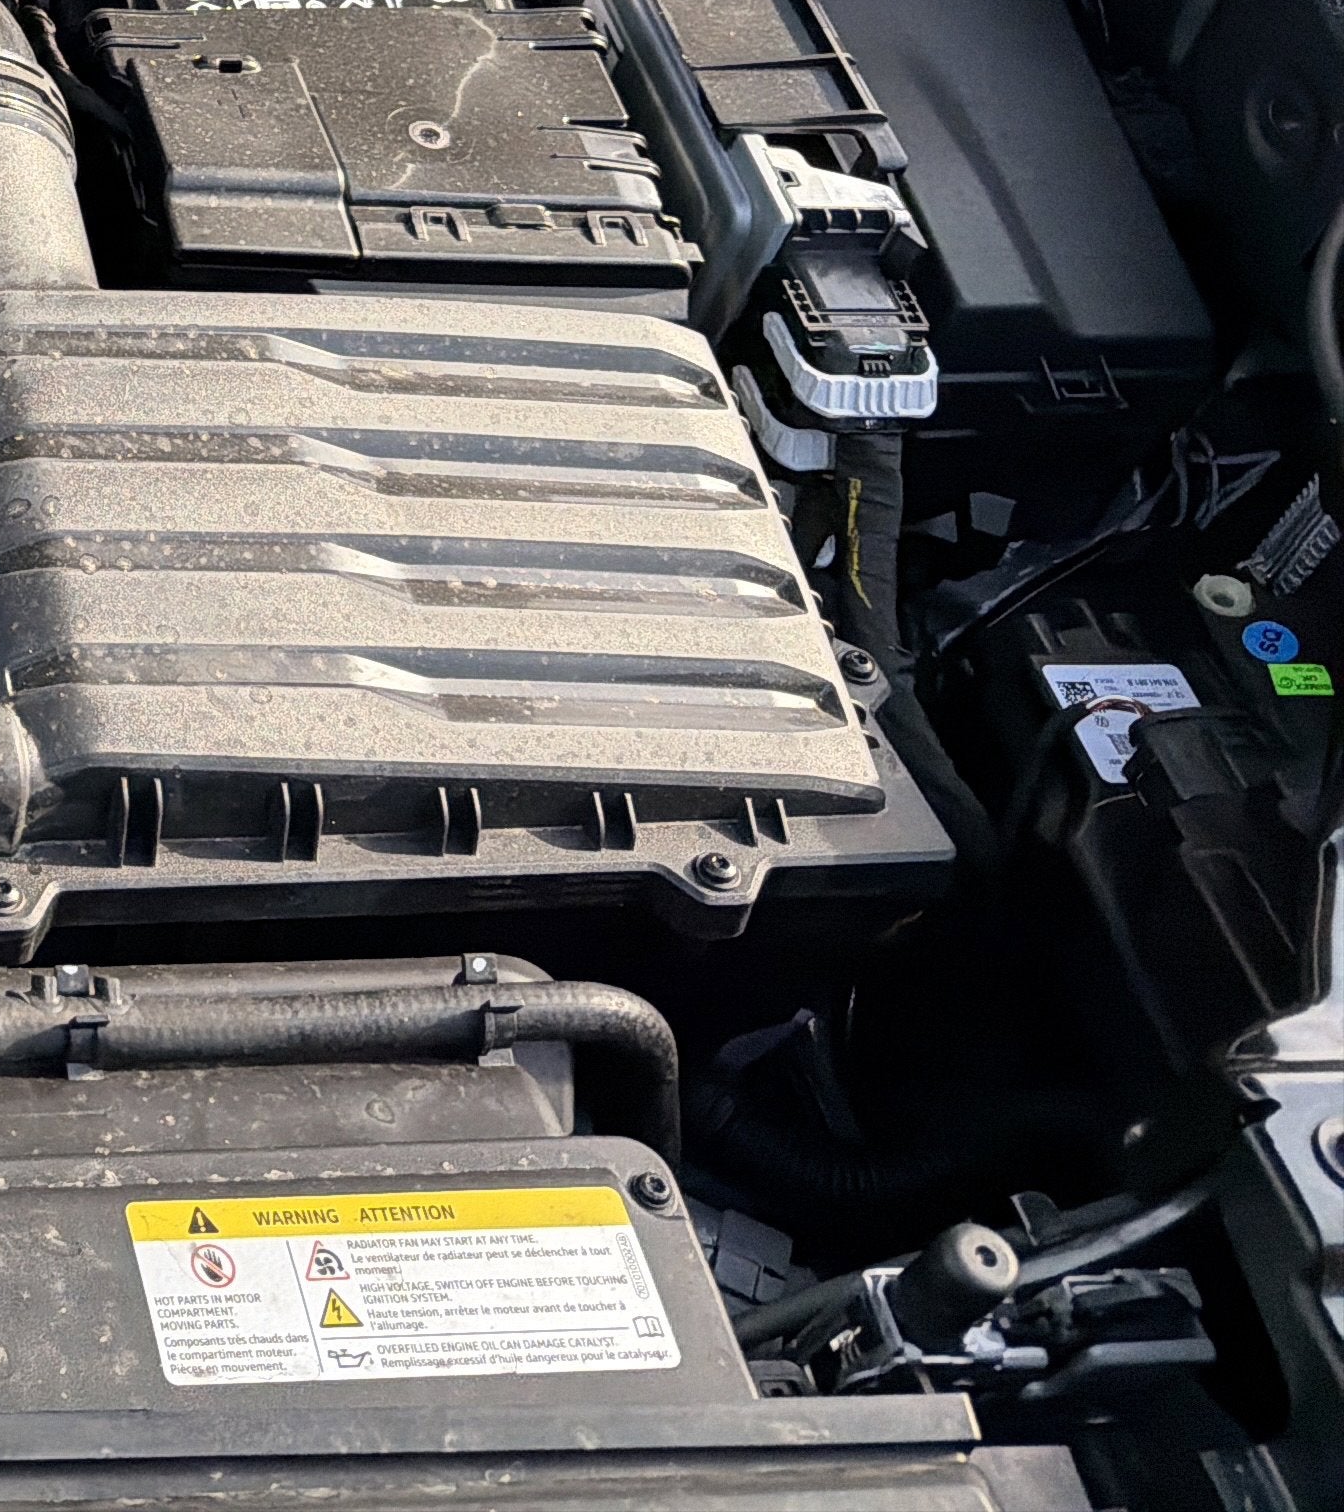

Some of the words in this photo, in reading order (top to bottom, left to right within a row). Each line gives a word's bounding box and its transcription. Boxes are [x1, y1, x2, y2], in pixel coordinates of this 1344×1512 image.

[252, 1209, 339, 1226] WARNING
[359, 1204, 456, 1223] ATTENTION
[346, 1238, 397, 1250] RADIATOR
[398, 1237, 419, 1248] FAN
[421, 1236, 442, 1247] MAY
[444, 1236, 473, 1247] START
[475, 1235, 487, 1246] AT
[489, 1235, 509, 1245] ANY
[510, 1234, 539, 1244] TIME.
[350, 1253, 364, 1264] Le
[366, 1252, 420, 1263] ventilateur
[422, 1251, 436, 1262] de
[437, 1250, 483, 1261] radiateur
[485, 1249, 509, 1262] peut
[510, 1249, 523, 1259] se
[524, 1246, 579, 1258] déclencher
[580, 1245, 588, 1256] à
[359, 1282, 385, 1293] HIGH
[434, 1279, 473, 1290] SWITCH
[475, 1278, 494, 1289] OFF
[496, 1277, 535, 1289] ENGINE
[536, 1276, 575, 1287] BEFORE
[577, 1274, 628, 1286] TOUCHING
[154, 1296, 175, 1306] HOT
[177, 1294, 209, 1306] PARTS
[211, 1294, 223, 1304] IN
[224, 1293, 262, 1304] MOTOR
[362, 1293, 409, 1306] IGNITION
[411, 1292, 453, 1304] SYSTEM.
[157, 1306, 238, 1319] COMPARTMENT.
[366, 1307, 399, 1320] Haute
[401, 1307, 443, 1319] tension,
[444, 1305, 479, 1317] arrêter
[480, 1305, 490, 1315] le
[492, 1304, 530, 1315] moteur
[532, 1303, 562, 1314] avant
[563, 1302, 577, 1313] de
[577, 1301, 617, 1312] toucher
[619, 1300, 627, 1311] à
[160, 1319, 203, 1331] MOVING
[204, 1318, 240, 1330] PARTS.
[369, 1319, 429, 1332] l'allumage.
[164, 1336, 227, 1349] Composants
[227, 1334, 248, 1346] très
[248, 1333, 284, 1345] chauds
[284, 1333, 309, 1344] dans
[376, 1342, 439, 1355] OVERFILLED
[441, 1340, 479, 1353] ENGINE
[480, 1340, 498, 1351] OIL
[499, 1339, 522, 1350] CAN
[523, 1337, 566, 1350] DAMAGE
[568, 1336, 618, 1348] CATALYST.
[167, 1350, 177, 1361] le
[179, 1348, 253, 1362] compartiment
[255, 1347, 297, 1358] moteur.
[380, 1356, 447, 1370] Remplissage
[447, 1353, 488, 1367] excessif
[489, 1352, 523, 1364] d'huile
[525, 1350, 580, 1365] dangereux
[580, 1351, 605, 1364] pour
[606, 1349, 616, 1360] le
[617, 1349, 672, 1362] catalyseur.
[169, 1361, 205, 1375] Pièces
[207, 1363, 219, 1374] en
[221, 1361, 287, 1373] mouvement.
